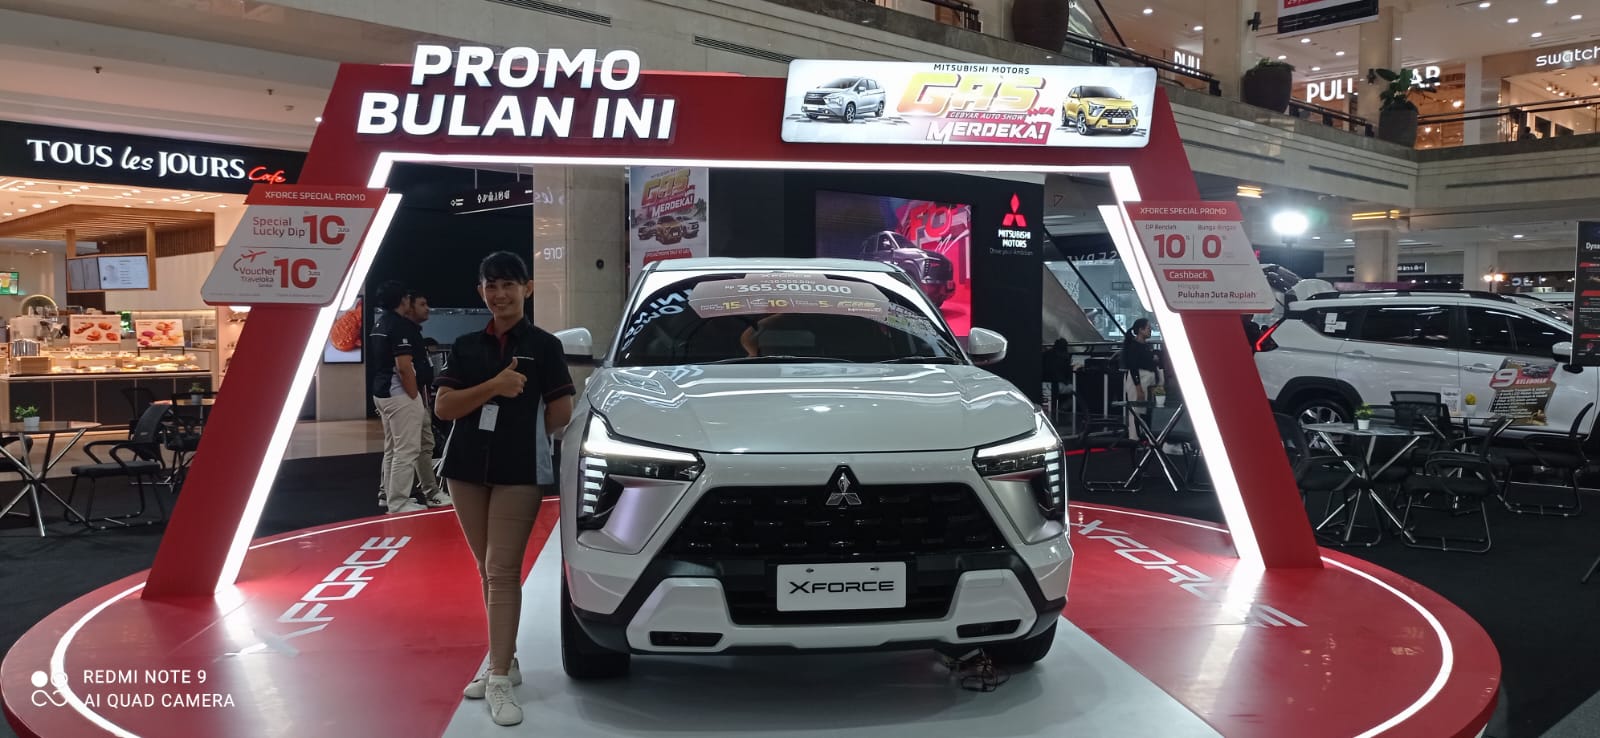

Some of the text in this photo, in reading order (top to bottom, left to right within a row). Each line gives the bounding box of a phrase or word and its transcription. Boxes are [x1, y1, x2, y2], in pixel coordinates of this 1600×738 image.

[411, 44, 641, 91] PROMO
[933, 63, 1030, 75] MITSUBISHI MOTORS
[897, 73, 1046, 117] GAS
[357, 92, 675, 139] BULAN INI
[926, 121, 1047, 144] MERDEKA!
[26, 139, 287, 184] TOUS les JOURS Cafe
[265, 191, 366, 201] XFORCE SPECIAL PROMO
[1140, 207, 1227, 215] XFORCE SPECIAL PROMO
[253, 216, 292, 227] Special
[253, 227, 306, 238] Lucky Dip
[998, 229, 1031, 239] MITSUBISHI
[1002, 239, 1027, 248] MOTORS
[240, 267, 277, 275] Voucher
[1169, 271, 1208, 280] Cashback
[737, 283, 851, 295] 365.900.000
[1177, 291, 1210, 299] Puluhan
[1229, 291, 1256, 299] Rupiah
[789, 580, 895, 594] XFORCE
